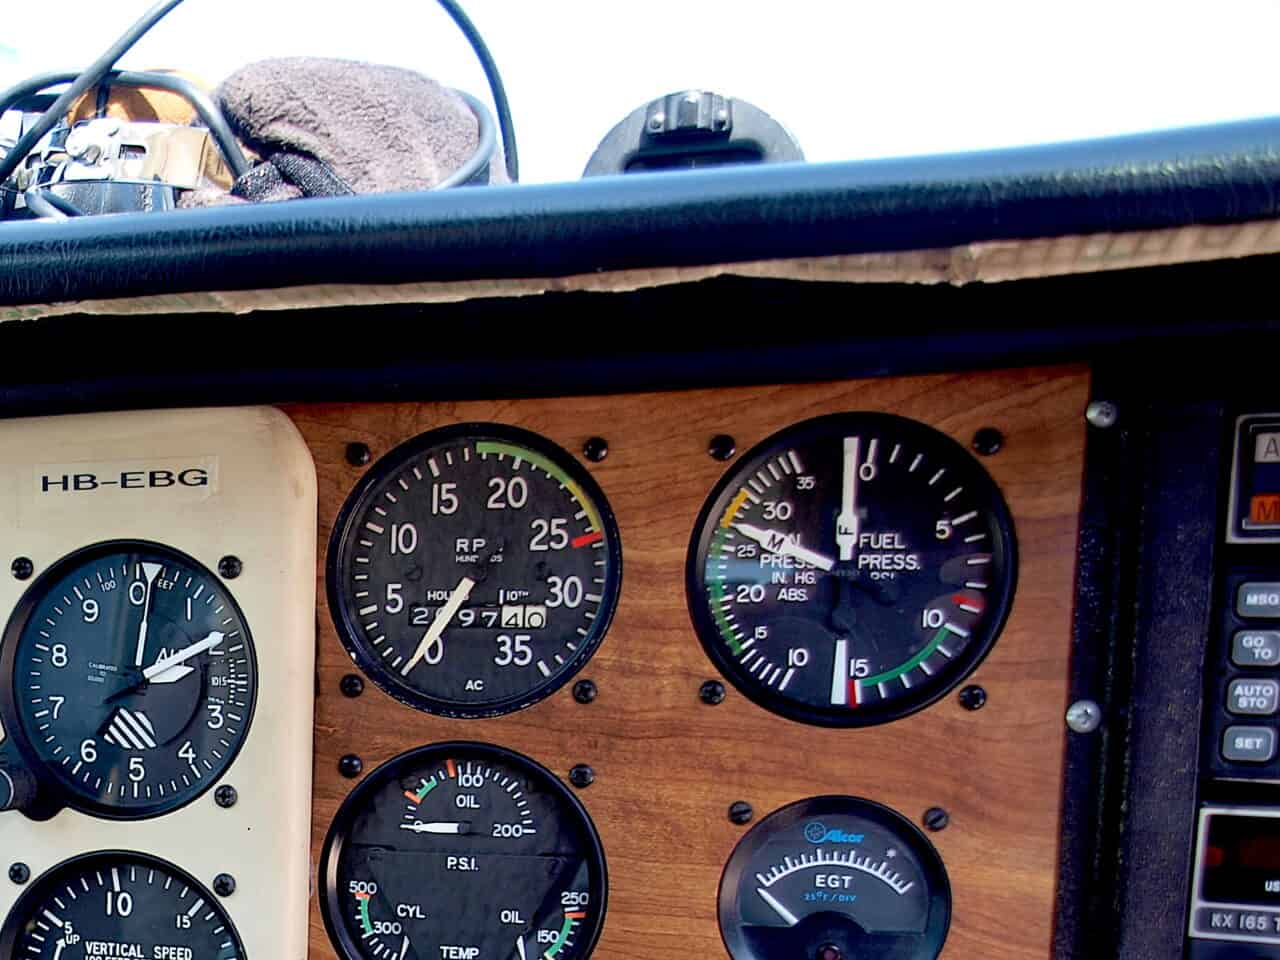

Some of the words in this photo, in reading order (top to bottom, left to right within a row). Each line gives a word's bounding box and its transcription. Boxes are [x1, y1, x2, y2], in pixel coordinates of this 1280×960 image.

[42, 469, 208, 491] HB-EBG
[859, 463, 875, 481] 0
[797, 476, 814, 490] 35
[432, 483, 458, 514] 15
[487, 476, 528, 509] 20
[763, 503, 791, 520] 30
[529, 518, 568, 550] 25
[935, 521, 952, 539] 5
[391, 524, 417, 554] 10
[859, 534, 905, 549] FUEL
[859, 555, 920, 570] PRESS.
[129, 582, 145, 604] 0
[386, 584, 403, 613] 5
[545, 576, 582, 608] 30
[737, 585, 764, 602] 20
[777, 589, 808, 601] ABS.
[83, 600, 98, 621] 9
[923, 611, 943, 628] 10
[52, 645, 66, 667] 8
[494, 636, 532, 666] 35
[789, 649, 808, 666] 10
[850, 660, 869, 677] 15
[466, 680, 484, 690] AC
[49, 696, 64, 718] 7
[208, 705, 223, 728] 3
[81, 739, 96, 762] 6
[1235, 737, 1263, 749] SET
[178, 742, 196, 763] 4
[129, 758, 144, 780] 5
[458, 775, 483, 787] 100
[456, 796, 480, 808] OIL
[493, 824, 522, 837] 200
[447, 857, 478, 871] P.S.I.
[349, 881, 377, 894] 500
[815, 875, 853, 888] EGT
[107, 891, 132, 916] 10
[561, 892, 589, 904] 250
[397, 904, 425, 918] CYL
[501, 910, 524, 923] OIL
[177, 915, 190, 928] 15
[374, 922, 402, 934] 300
[1212, 914, 1232, 928] KX
[1240, 914, 1266, 928] 165
[66, 935, 80, 945] UP
[537, 931, 559, 942] 150
[85, 942, 144, 957] VERTICAL
[154, 946, 192, 960] SPEED
[440, 946, 479, 960] TEMP
